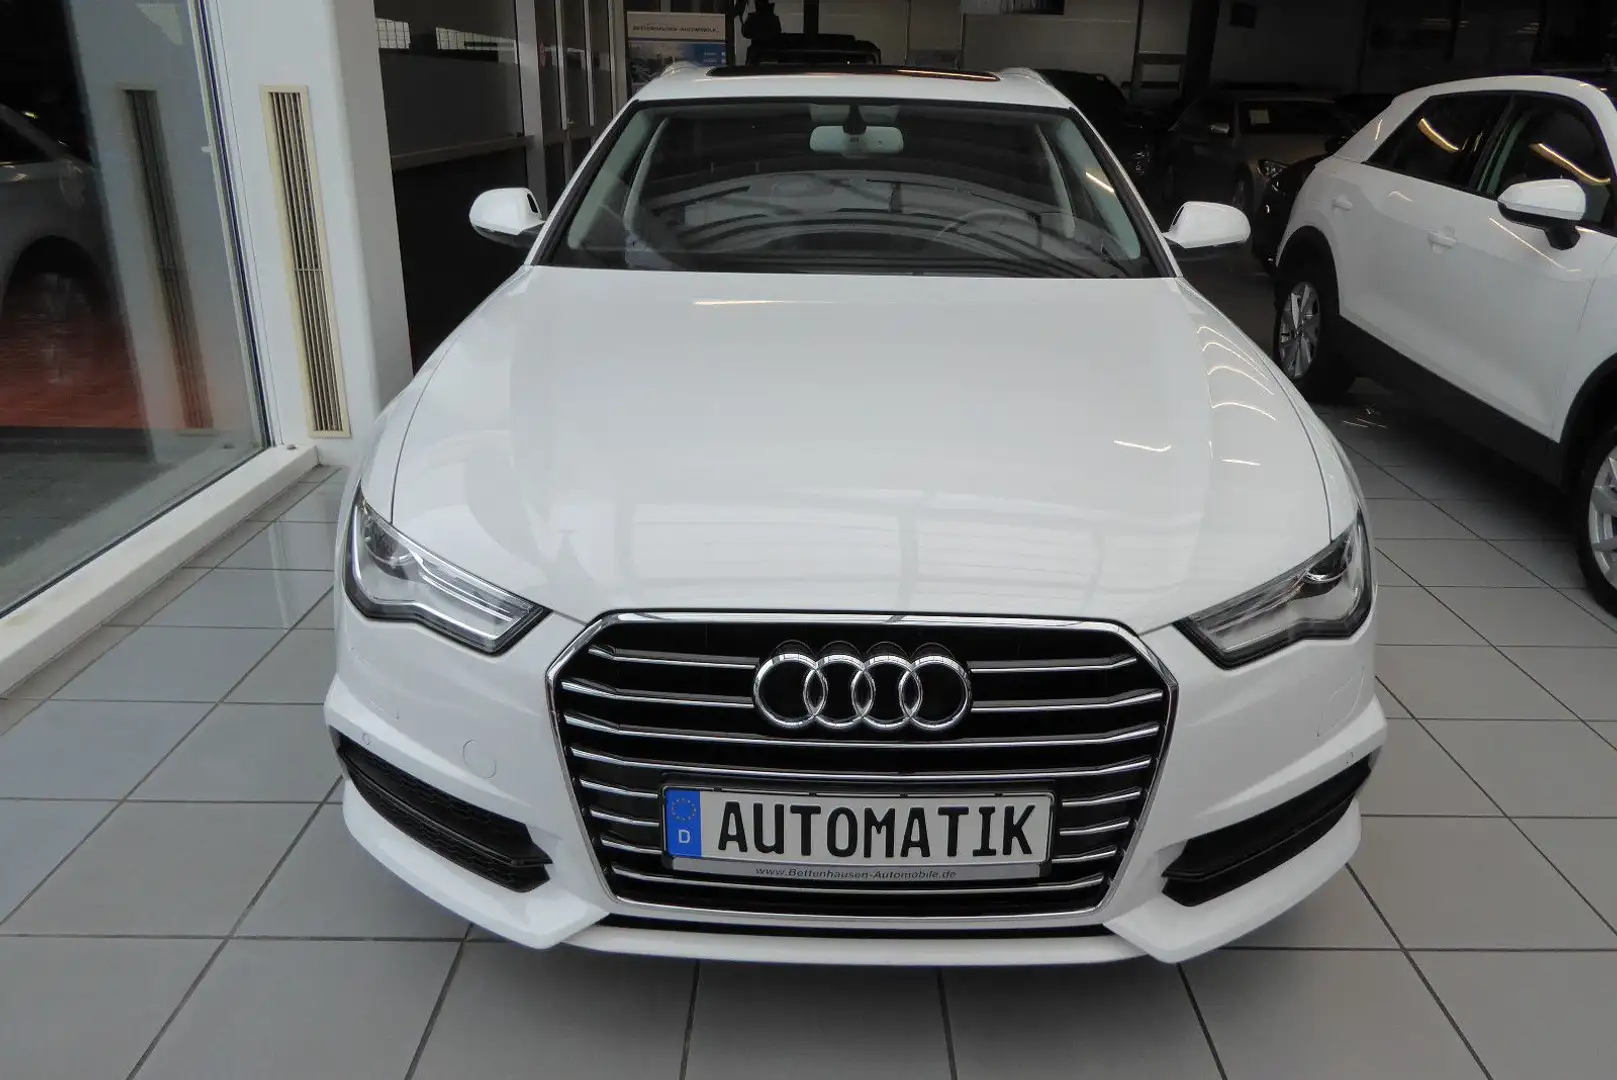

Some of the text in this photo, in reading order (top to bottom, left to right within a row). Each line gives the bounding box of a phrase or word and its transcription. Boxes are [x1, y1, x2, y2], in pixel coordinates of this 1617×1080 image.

[678, 829, 691, 844] D
[717, 801, 1035, 858] AUTOMATIK
[755, 867, 957, 879] www.Bettenhausen-Automobile.de
